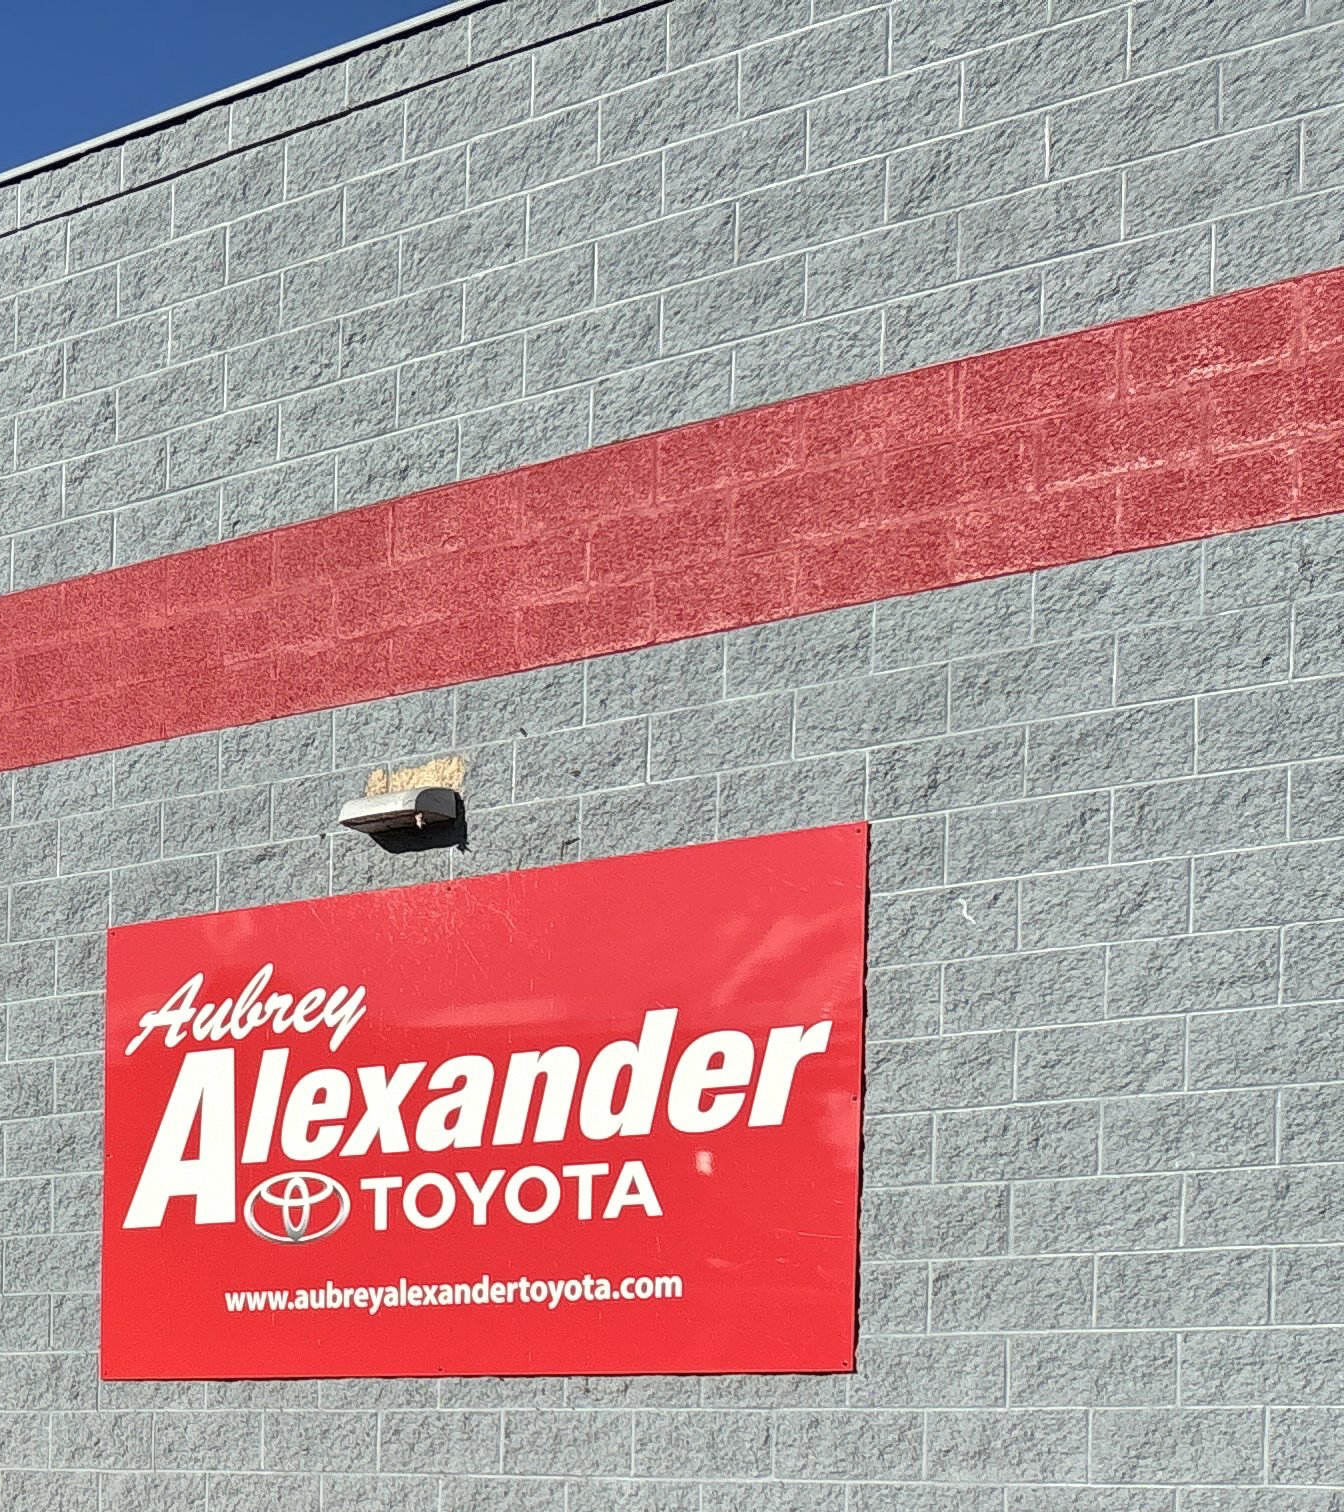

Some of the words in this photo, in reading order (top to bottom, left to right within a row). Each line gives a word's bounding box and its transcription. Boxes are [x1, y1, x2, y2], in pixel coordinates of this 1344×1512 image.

[124, 963, 368, 1055] Aubrey
[122, 1007, 833, 1229] Alexander
[360, 1160, 664, 1231] TOYOTA
[224, 1274, 683, 1315] www.aubreyalexandertoyota.com
